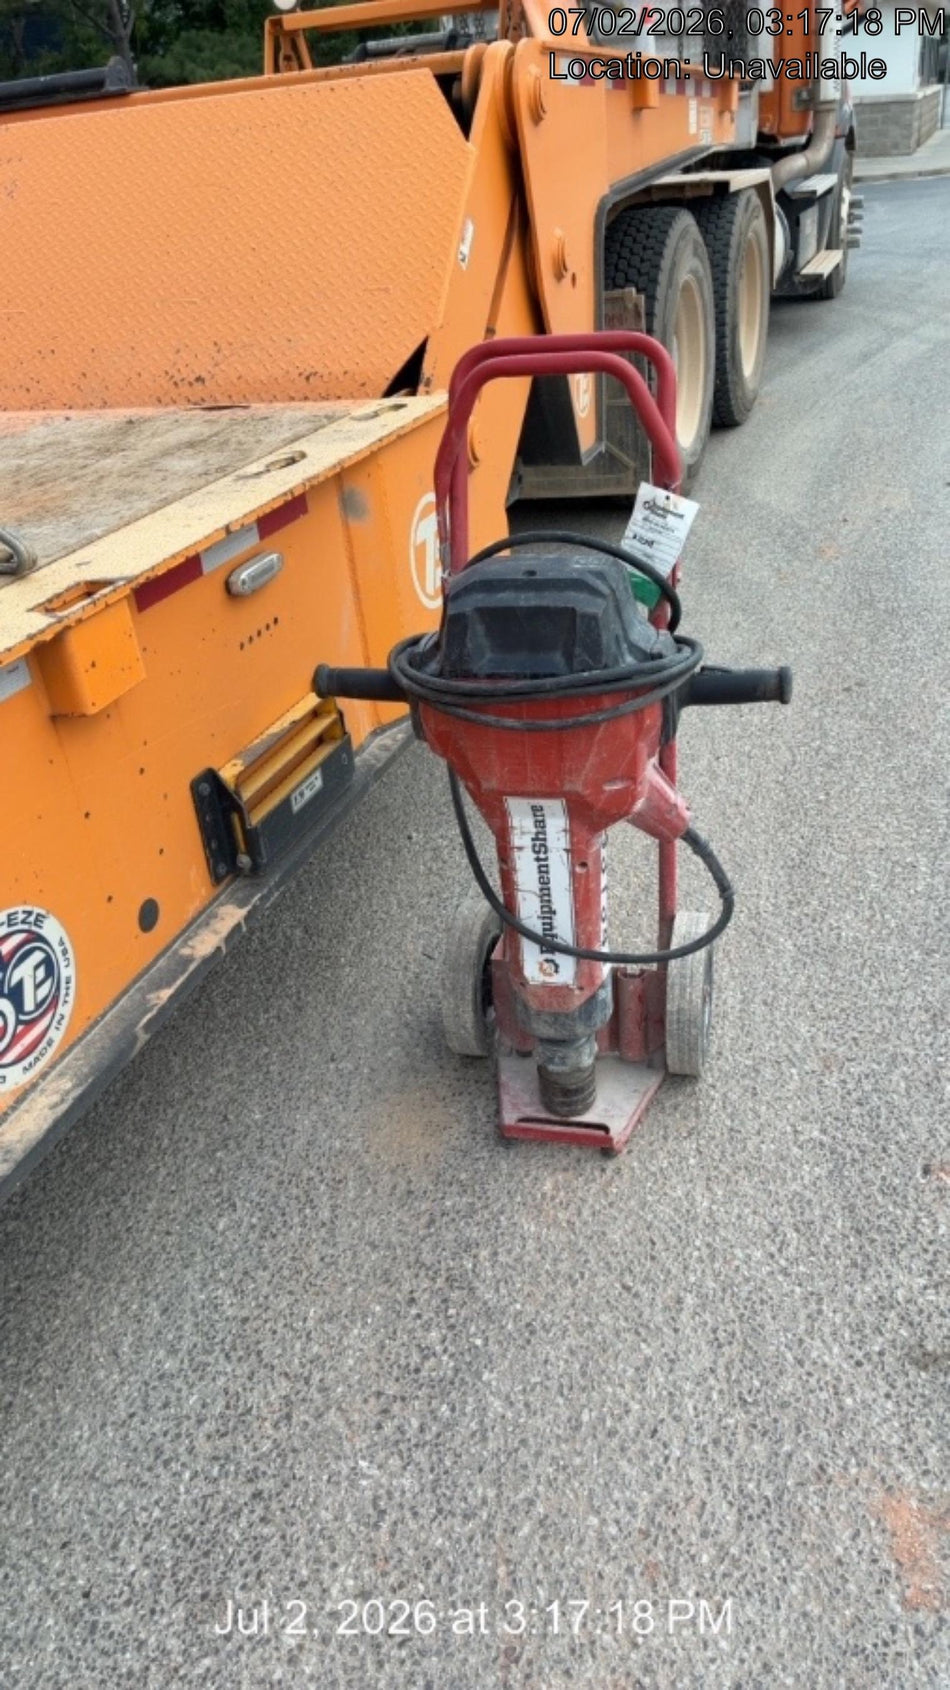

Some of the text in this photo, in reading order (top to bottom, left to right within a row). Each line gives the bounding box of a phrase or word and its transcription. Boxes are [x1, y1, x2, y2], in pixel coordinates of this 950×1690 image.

[23, 936, 72, 1074] MADE IN THE USA
